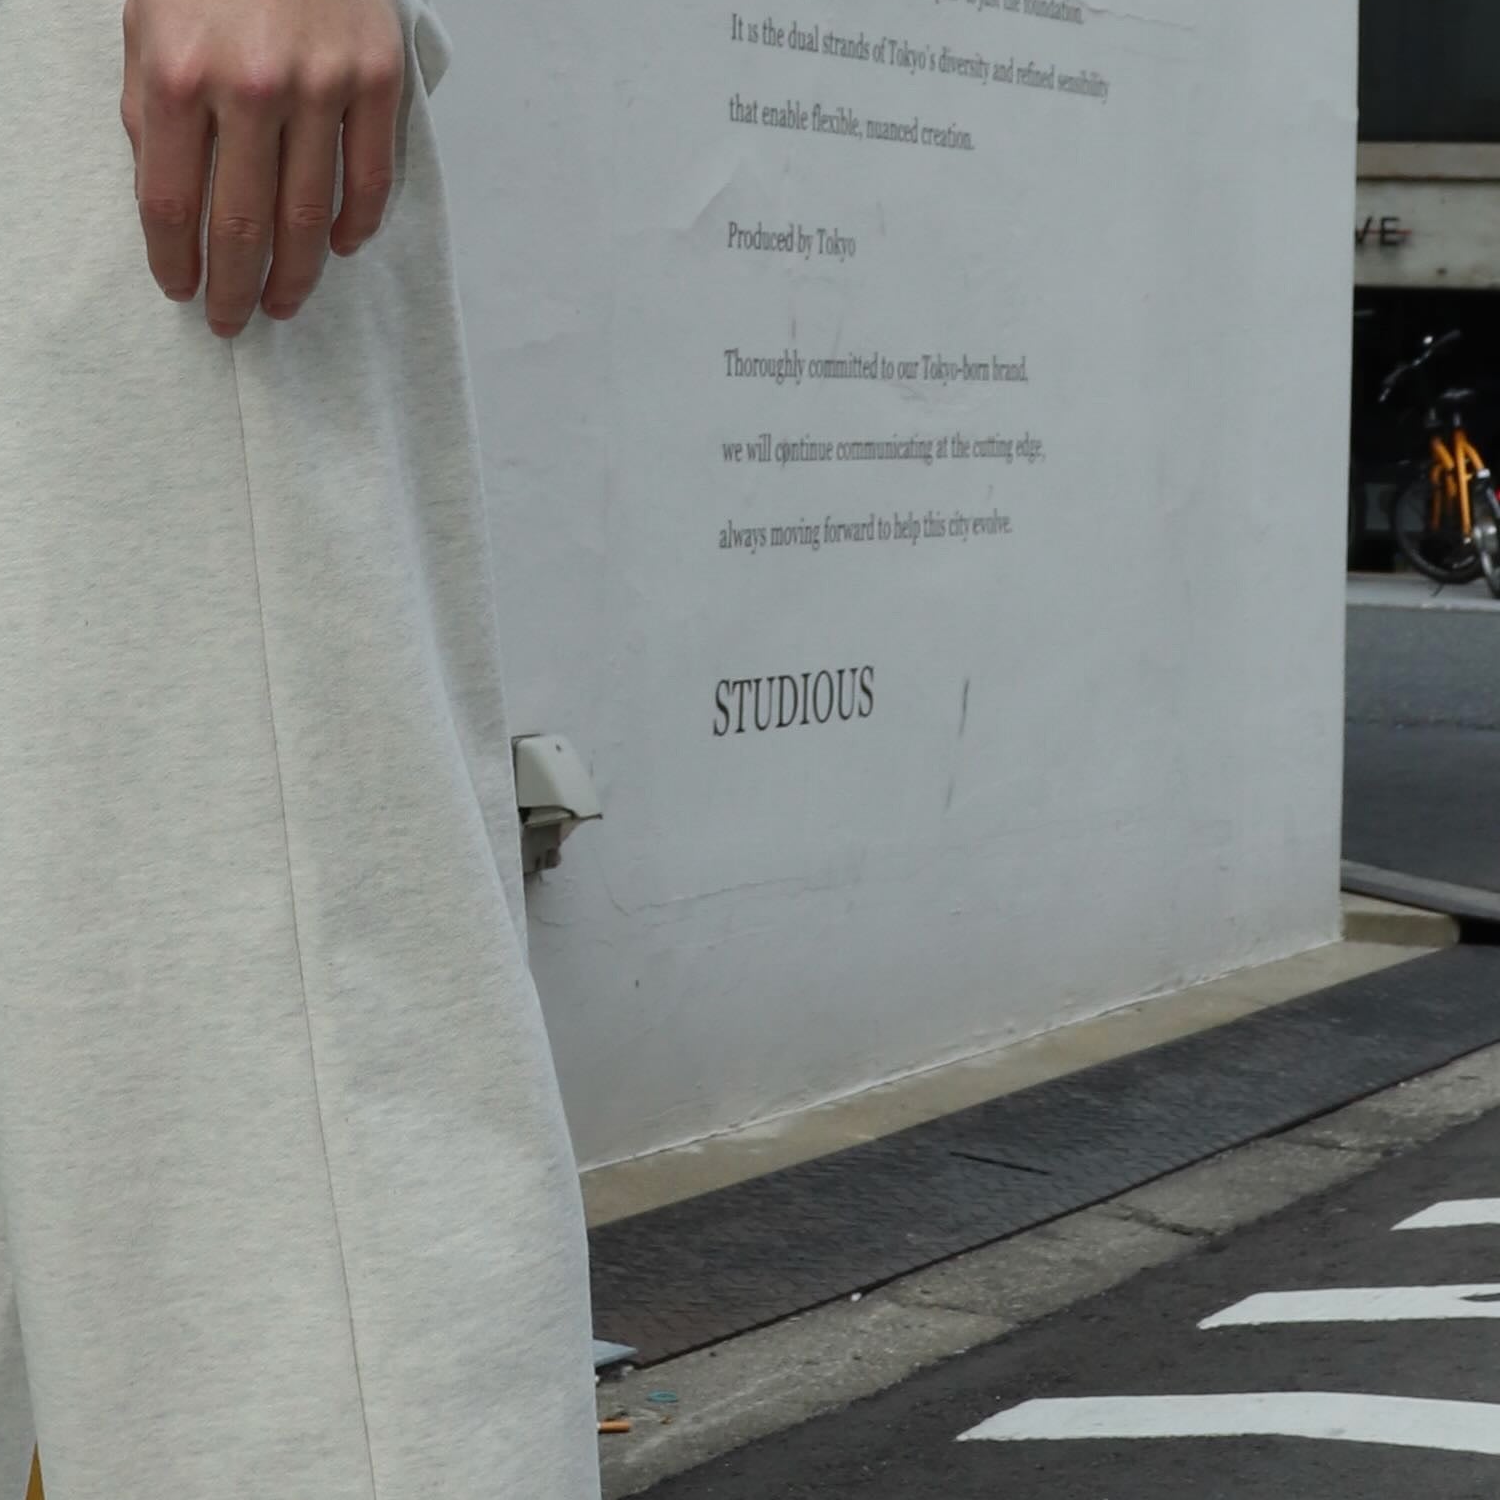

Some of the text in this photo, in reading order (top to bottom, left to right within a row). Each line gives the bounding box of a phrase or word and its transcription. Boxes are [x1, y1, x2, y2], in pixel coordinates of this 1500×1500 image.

[731, 13, 744, 41] It
[747, 22, 759, 43] is
[762, 16, 785, 47] the
[788, 20, 819, 53] dual
[822, 31, 870, 60] strands
[872, 36, 886, 63] of
[888, 40, 936, 76] Tokyo's
[938, 46, 990, 86] diversity
[992, 56, 1013, 84] and
[1016, 60, 1055, 91] refined
[729, 92, 975, 151] that enable flexible, nuanced creation.
[727, 221, 857, 263] Produced by Tokyo
[724, 348, 804, 386] Thoroughly
[808, 351, 879, 380] committed
[881, 356, 895, 380] to
[897, 361, 919, 380] our
[921, 353, 989, 387] Tokyo-born
[722, 442, 743, 462] we
[746, 433, 772, 462] will
[775, 433, 834, 465] continue
[836, 432, 934, 466] communicating
[936, 436, 949, 459] at
[951, 431, 970, 459] the
[972, 433, 1014, 465] cutting
[719, 519, 767, 555] always
[770, 517, 821, 552] moving
[824, 515, 875, 543] forward
[878, 516, 892, 541] to
[894, 511, 922, 546] help
[923, 510, 947, 537] this
[949, 509, 972, 542] city
[712, 664, 874, 737] STUDIOUS
